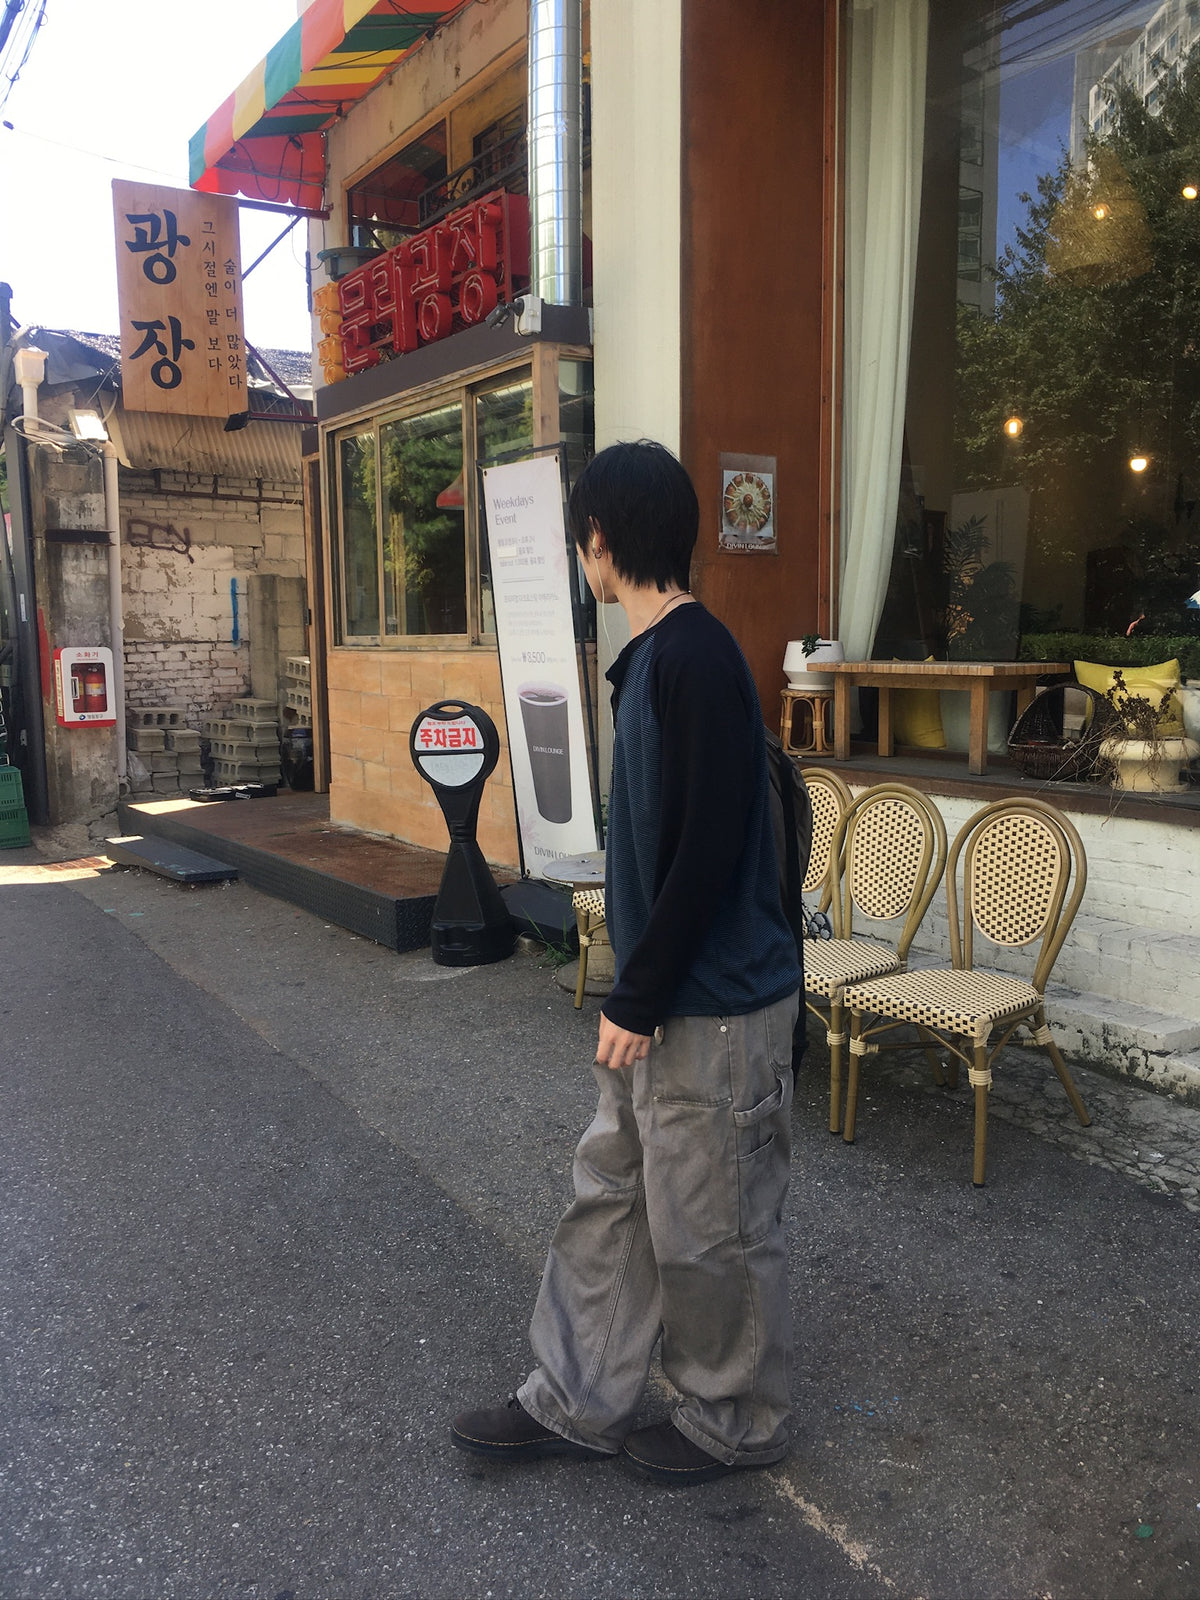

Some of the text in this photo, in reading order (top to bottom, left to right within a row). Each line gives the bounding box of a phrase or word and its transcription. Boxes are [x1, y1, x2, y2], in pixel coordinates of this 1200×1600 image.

[124, 208, 195, 390] 광장
[206, 309, 221, 326] 말
[223, 259, 243, 390] 술이 더 많았다
[207, 337, 223, 373] 보다
[492, 495, 535, 510] Weekdays
[495, 512, 517, 526] Event
[420, 727, 477, 748] 주차금지
